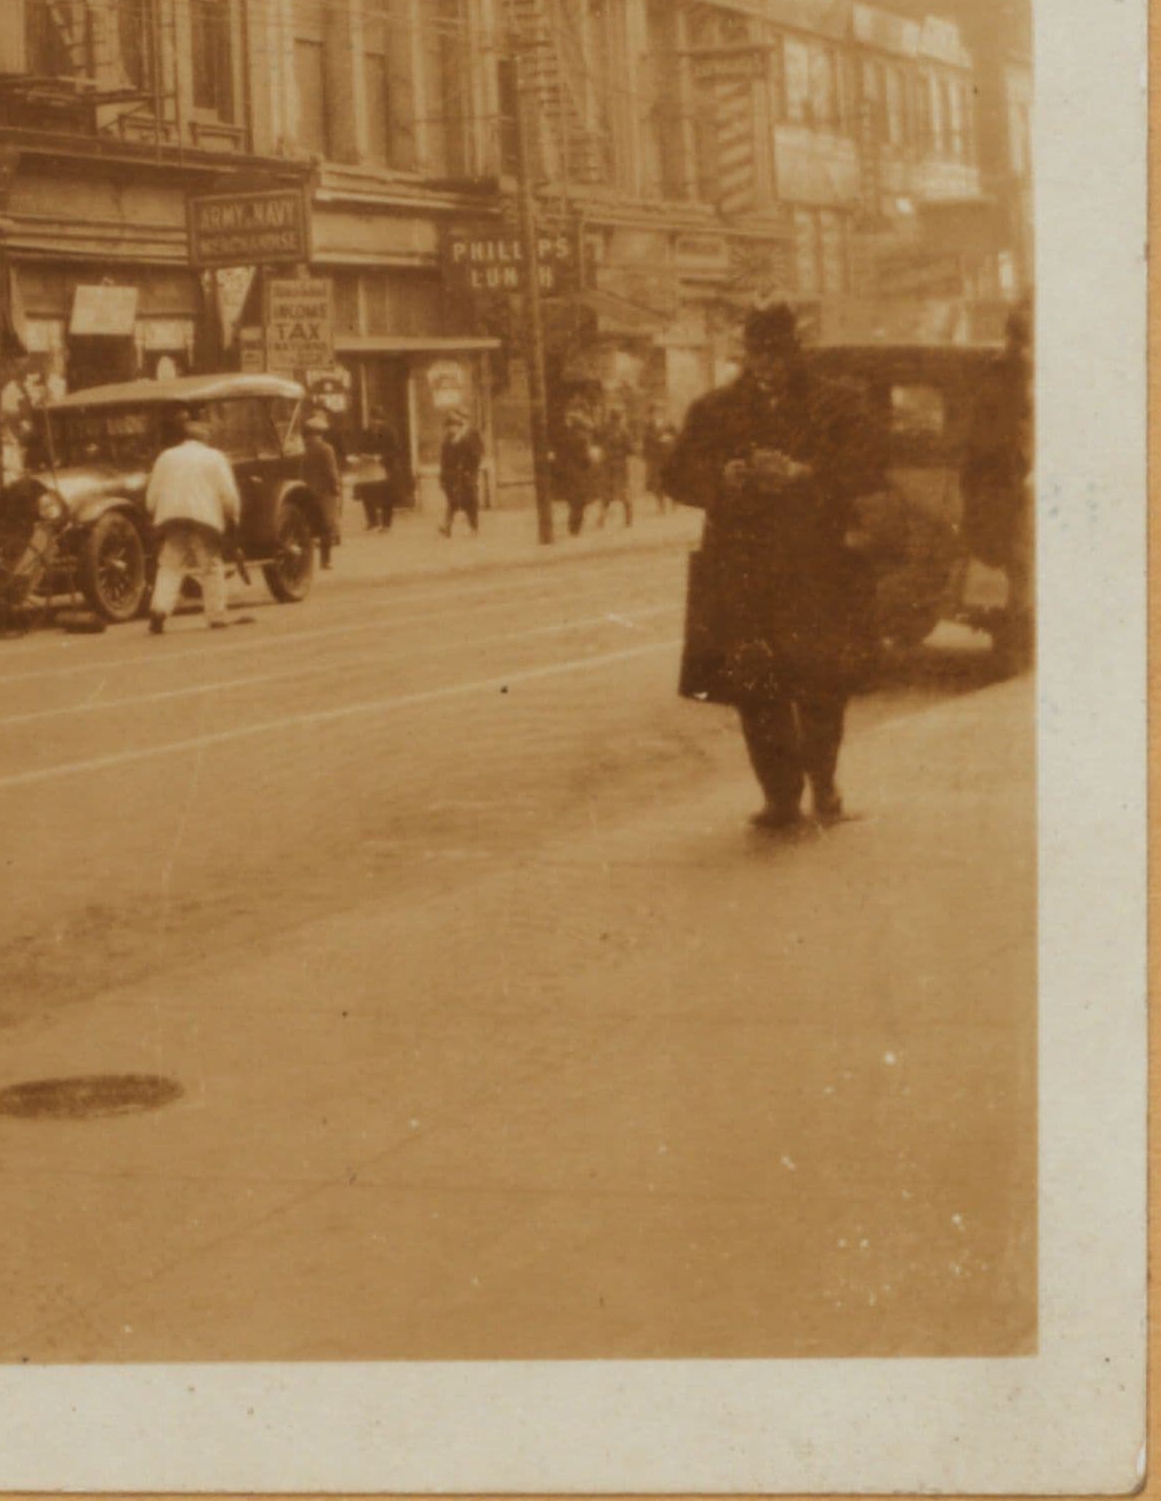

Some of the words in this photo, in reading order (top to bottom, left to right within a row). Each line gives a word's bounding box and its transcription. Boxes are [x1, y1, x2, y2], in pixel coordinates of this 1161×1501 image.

[200, 203, 243, 231] ARMY
[253, 199, 295, 227] NAVY
[452, 236, 570, 263] PHILLPS
[471, 266, 553, 289] LUNH
[275, 322, 321, 341] TAX
